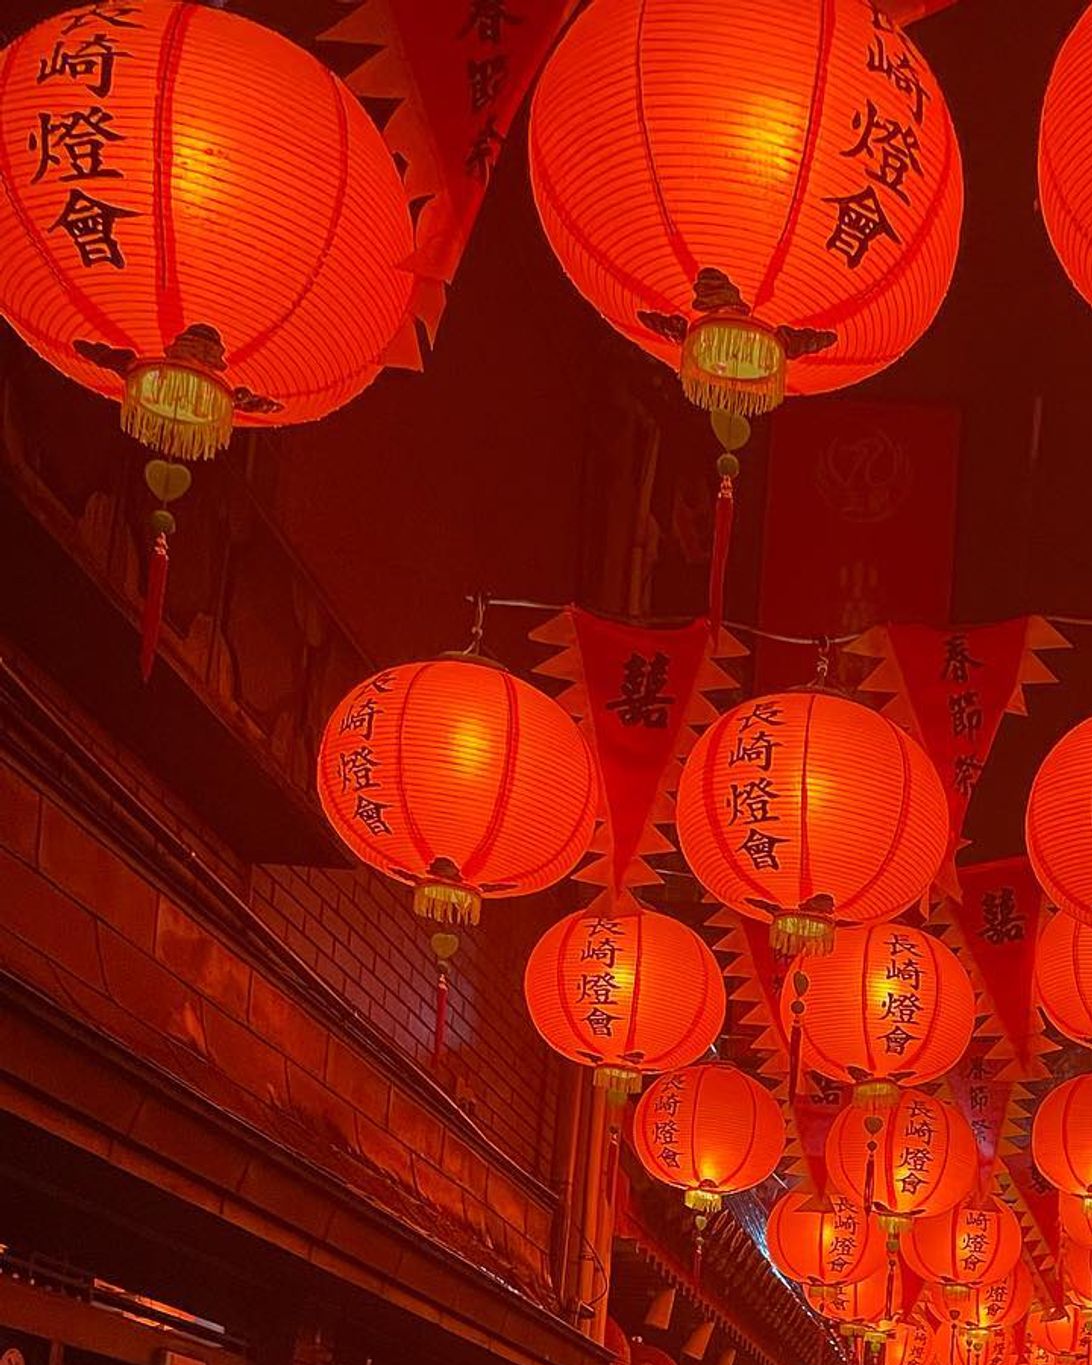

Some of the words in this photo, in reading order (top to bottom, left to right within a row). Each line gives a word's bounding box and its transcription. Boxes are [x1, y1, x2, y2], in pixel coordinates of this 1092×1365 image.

[726, 701, 792, 872] 長崎燈會
[576, 918, 625, 1037] 長崎燈會
[876, 933, 926, 1056] 長崎燈會
[896, 1100, 937, 1195] 長崎燈會
